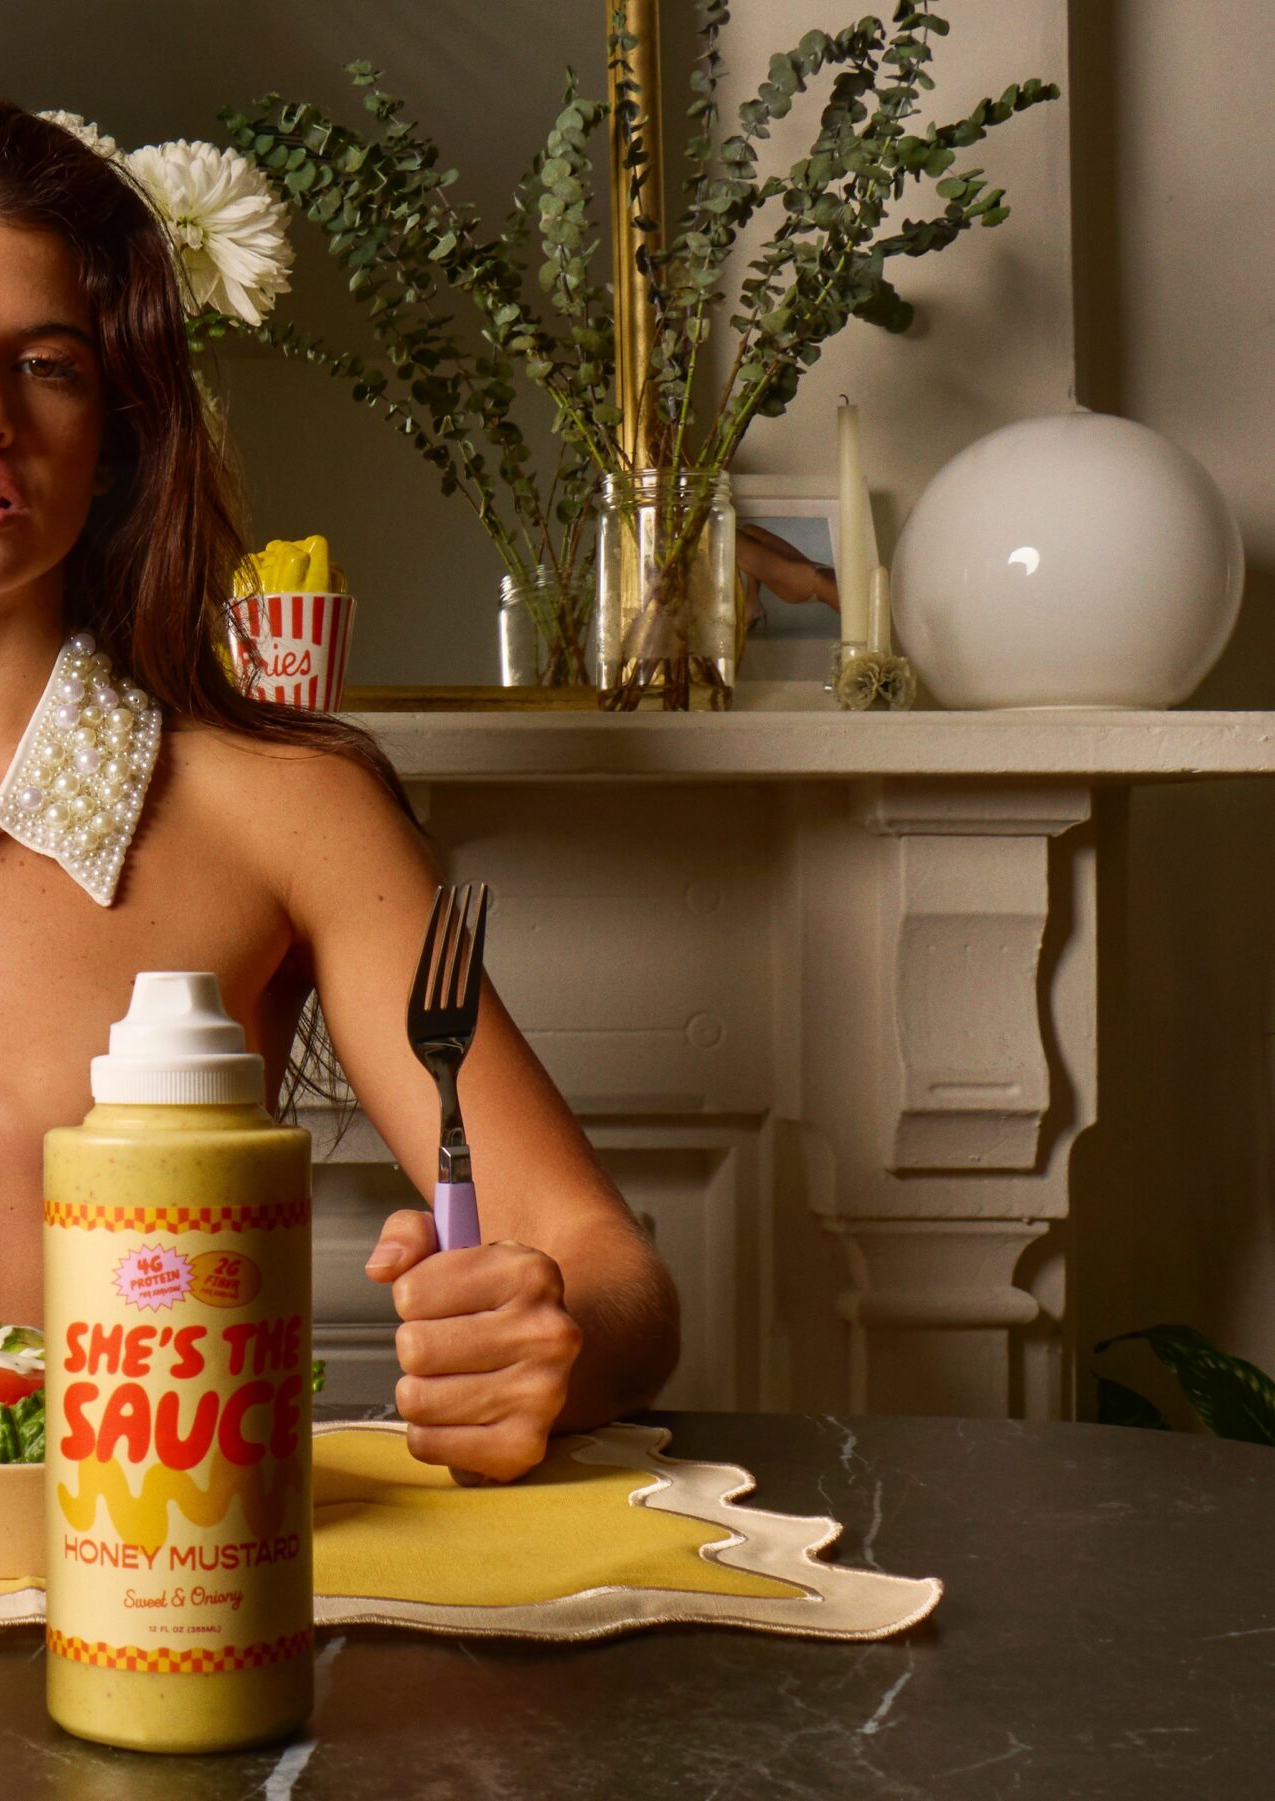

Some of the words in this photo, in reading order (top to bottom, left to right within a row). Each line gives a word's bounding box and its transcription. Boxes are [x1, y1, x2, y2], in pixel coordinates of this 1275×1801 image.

[137, 1255, 163, 1275] 4G
[214, 1257, 243, 1277] 2G
[130, 1269, 181, 1290] PROTEIN
[203, 1275, 241, 1294] FIBER
[64, 1321, 207, 1379] SHE'S
[222, 1314, 302, 1376] THE
[61, 1375, 302, 1471] SAUCE
[64, 1534, 166, 1571] HONEY
[170, 1535, 299, 1571] MUSTARD
[123, 1588, 167, 1609] Sweet
[171, 1587, 186, 1607] &
[190, 1586, 244, 1611] Oniony
[148, 1625, 157, 1633] 12
[160, 1625, 169, 1633] FL
[173, 1625, 184, 1633] OZ
